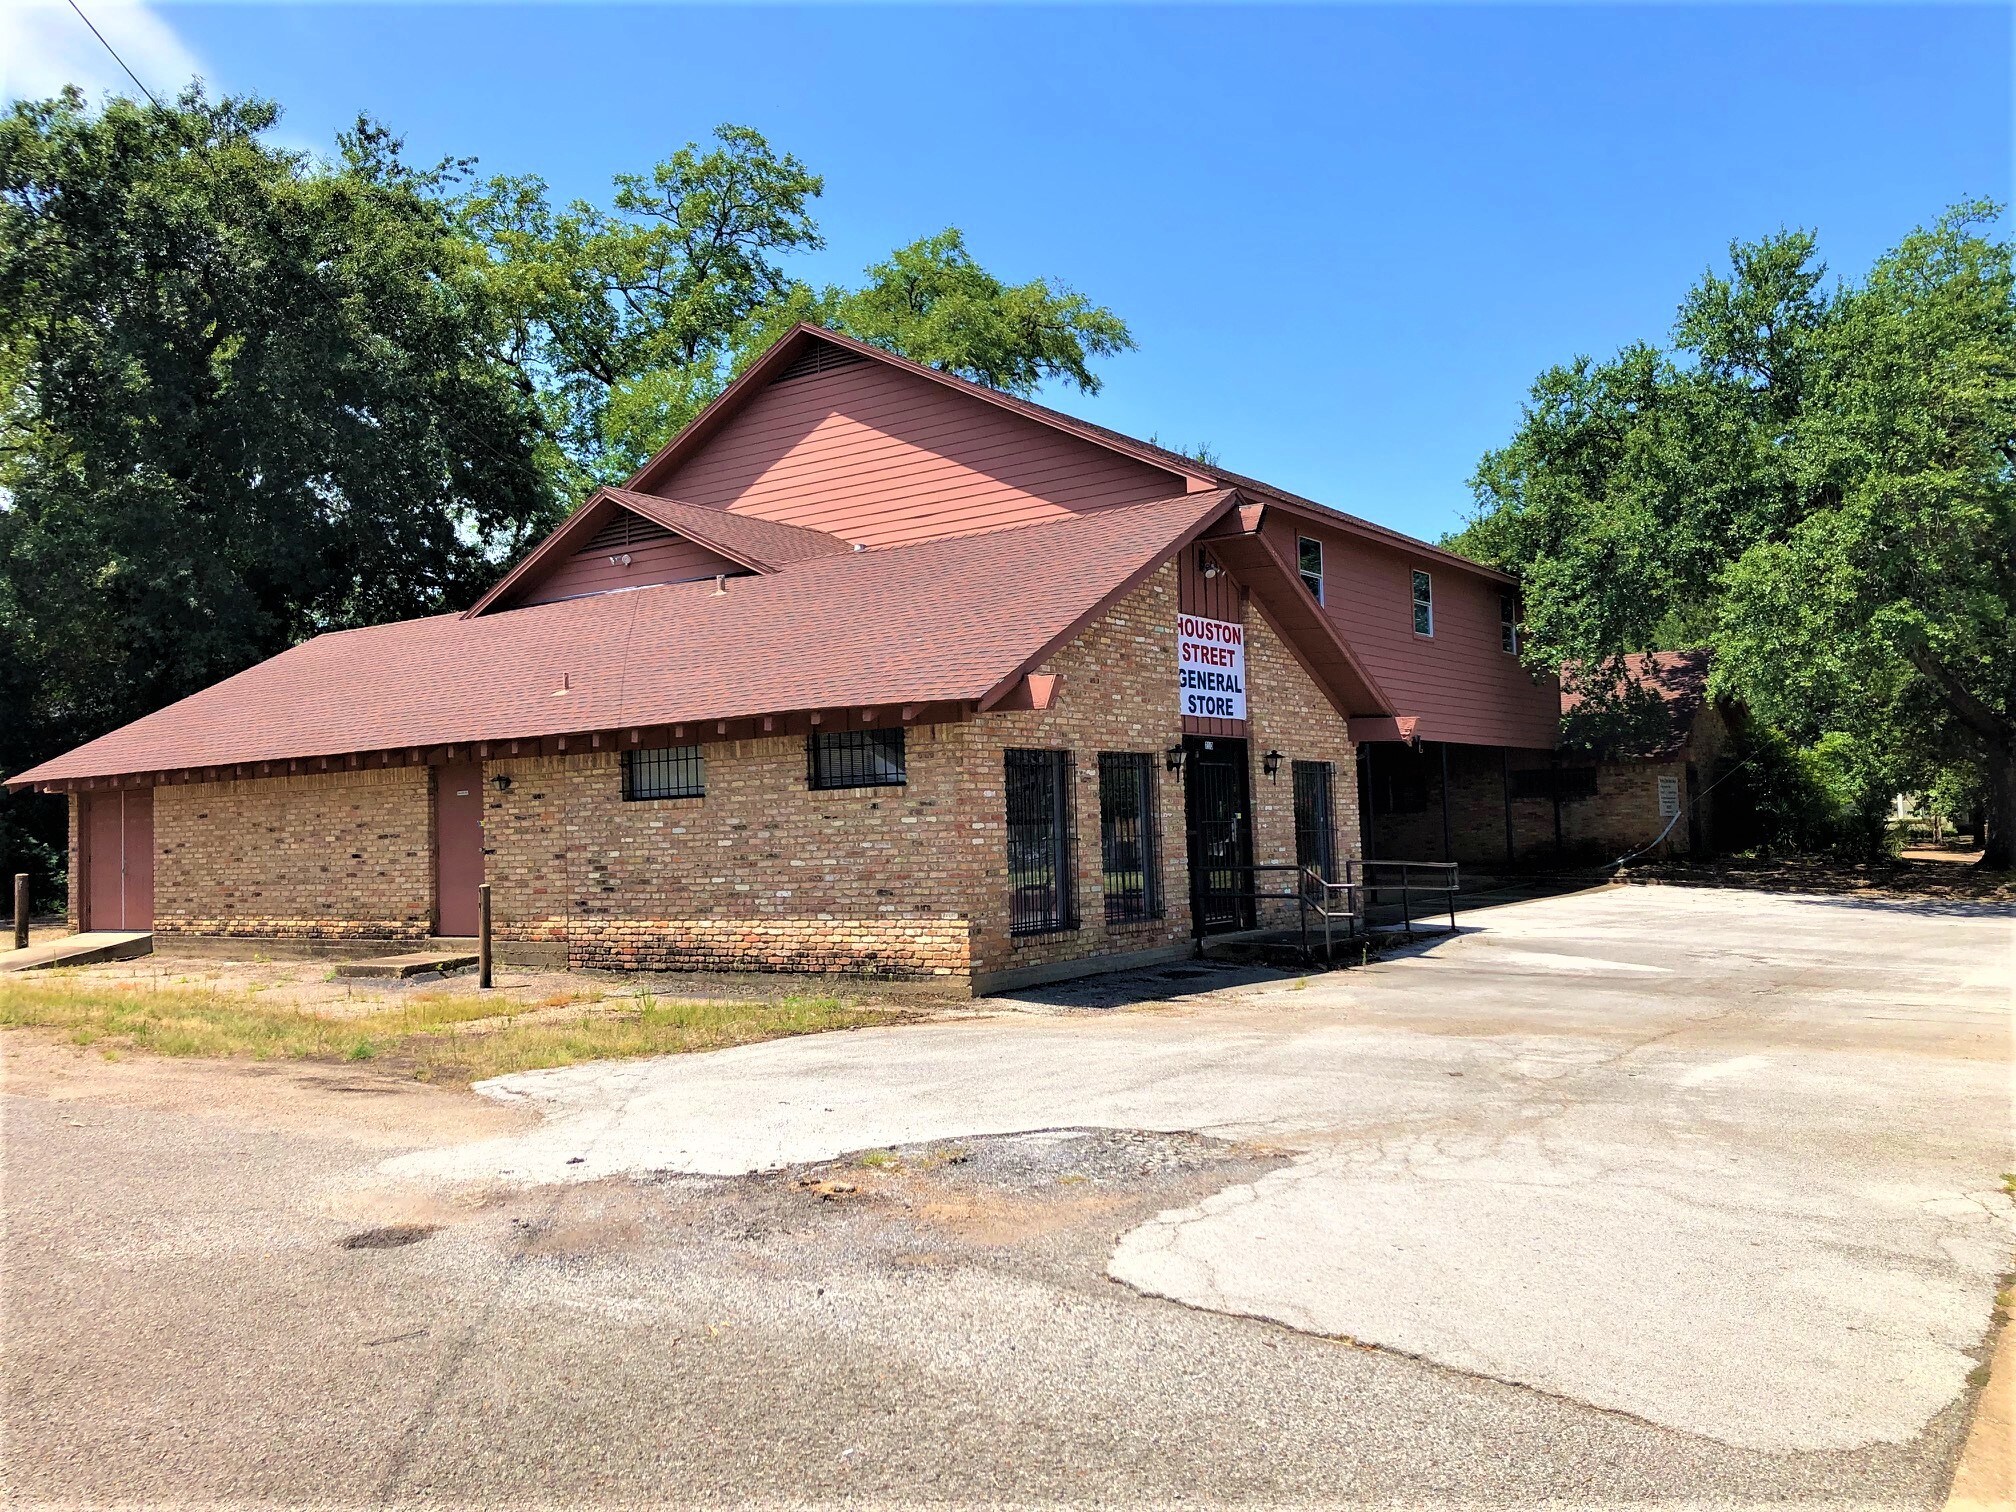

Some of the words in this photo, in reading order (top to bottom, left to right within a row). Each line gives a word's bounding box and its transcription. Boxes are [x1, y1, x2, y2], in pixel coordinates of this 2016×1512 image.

[1182, 642, 1235, 667] STREET
[1179, 669, 1242, 693] GENERAL
[1188, 694, 1234, 716] STORE
